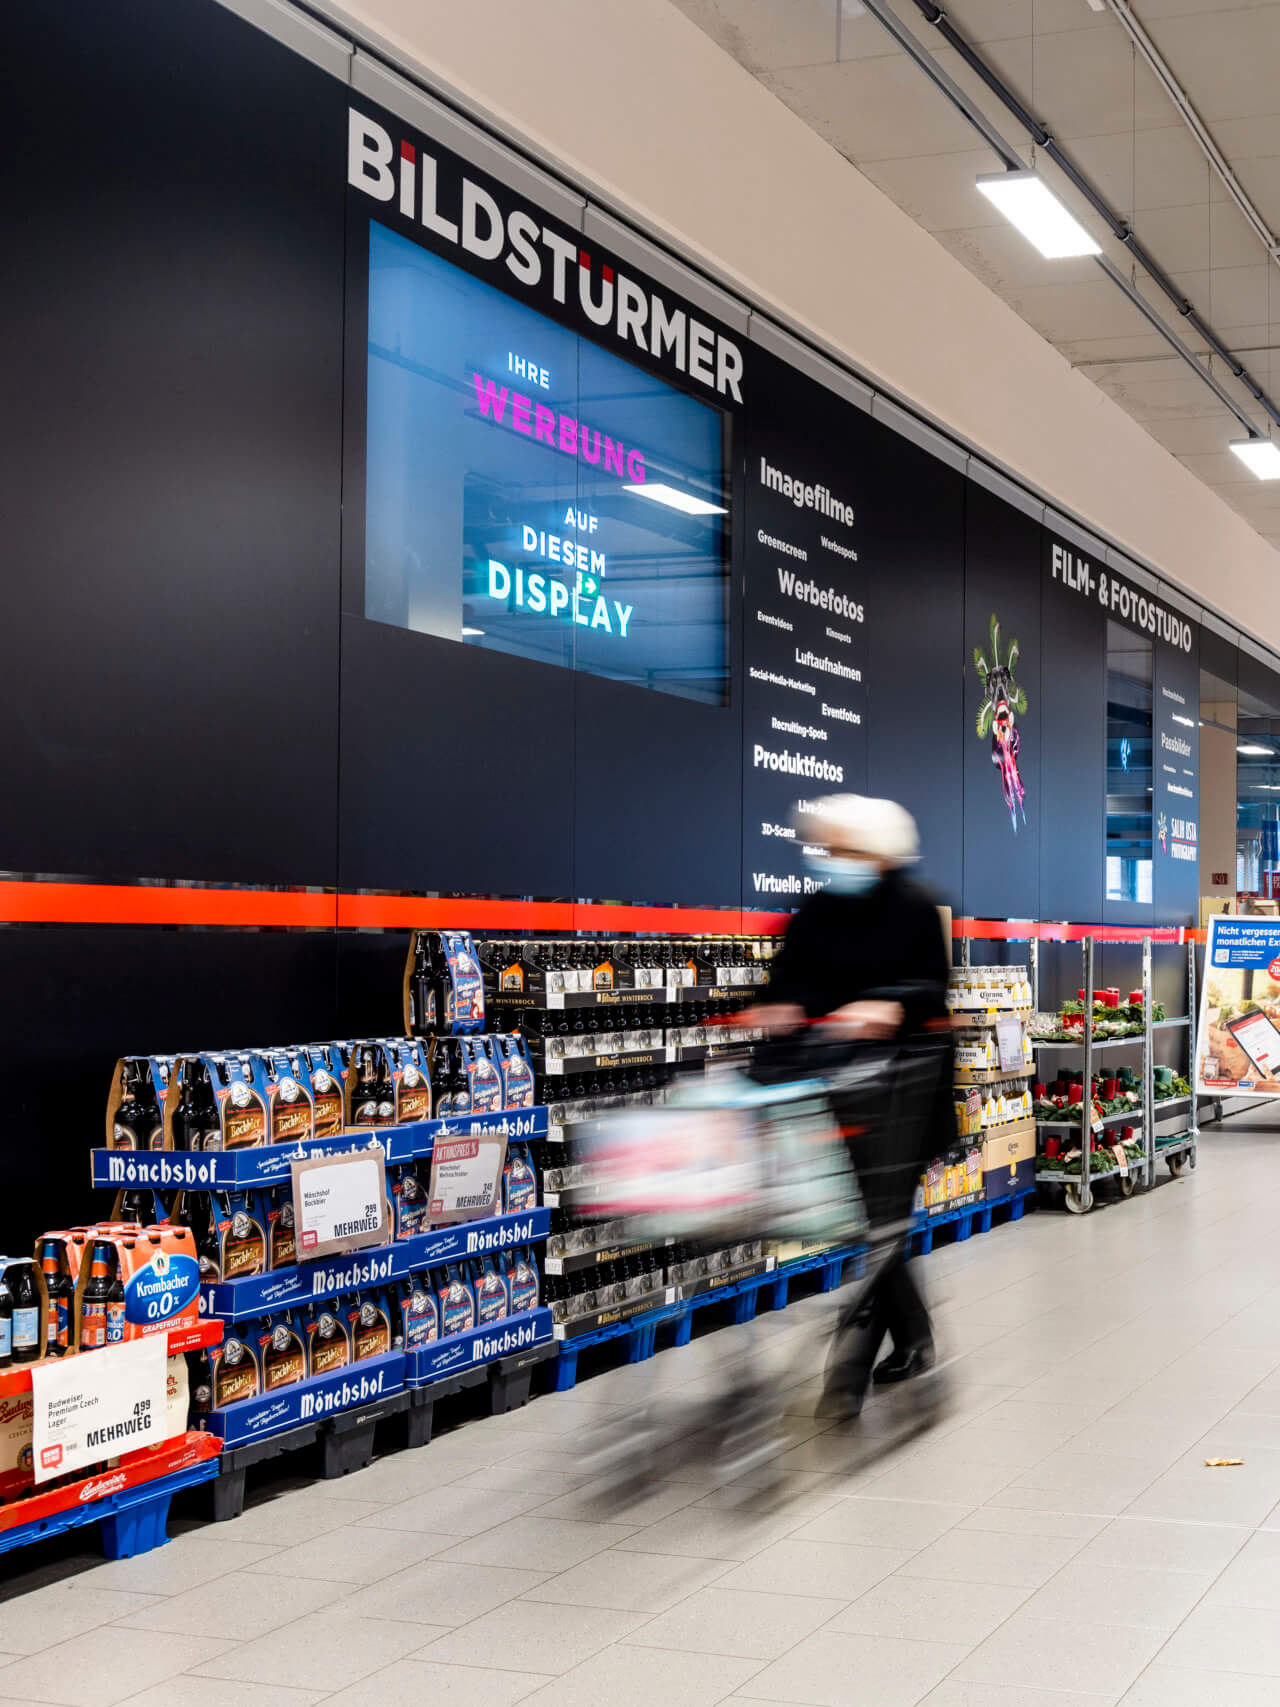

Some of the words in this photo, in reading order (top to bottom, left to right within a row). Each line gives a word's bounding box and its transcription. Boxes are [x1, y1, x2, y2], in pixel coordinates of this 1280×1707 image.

[507, 352, 550, 390] IHRE
[473, 372, 646, 484] WERBUNG
[760, 456, 854, 526] Imagefilme
[564, 507, 598, 534] AUF
[522, 525, 606, 576] DIESEM
[757, 529, 807, 561] Greenscreen
[820, 535, 858, 561] Werbespots
[488, 559, 633, 638] DISPLAY
[777, 567, 864, 623] Werbefotos
[1052, 543, 1095, 597] FILM-
[1098, 572, 1109, 607] &
[1111, 579, 1192, 653] FOTOSTUDIO
[757, 610, 794, 632] Eventvideos
[795, 647, 862, 683] Luftaufnahmen
[749, 666, 816, 696] Social-Media-Marketing
[821, 702, 861, 725] Eventfotos
[771, 716, 828, 741] Recruiting-Spots
[753, 744, 844, 783] Produktfotos
[761, 823, 796, 838] 3D-Scans
[753, 872, 802, 894] Virtuelle
[1216, 937, 1266, 946] monatlichen
[1217, 926, 1239, 935] Nicht
[622, 993, 653, 1002] WINTERBOCK
[621, 1056, 653, 1065] WINTERBOCK
[109, 1157, 217, 1184] Mönchshof
[456, 1194, 491, 1208] MEHRWEG
[333, 1217, 378, 1238] MEHRWEG
[467, 1219, 534, 1254] Mönchshof
[136, 1274, 190, 1298] Krombacher
[313, 1254, 394, 1296] Mönchshof
[142, 1318, 181, 1334] GRAPEFRUIT
[473, 1322, 537, 1362] Mönchshof
[48, 1394, 83, 1410] Budweiser
[48, 1404, 78, 1418] Premium
[79, 1396, 99, 1409] Czech
[301, 1370, 385, 1419] Mönchshof
[48, 1418, 67, 1428] Lager
[87, 1414, 151, 1448] MEHRWEG
